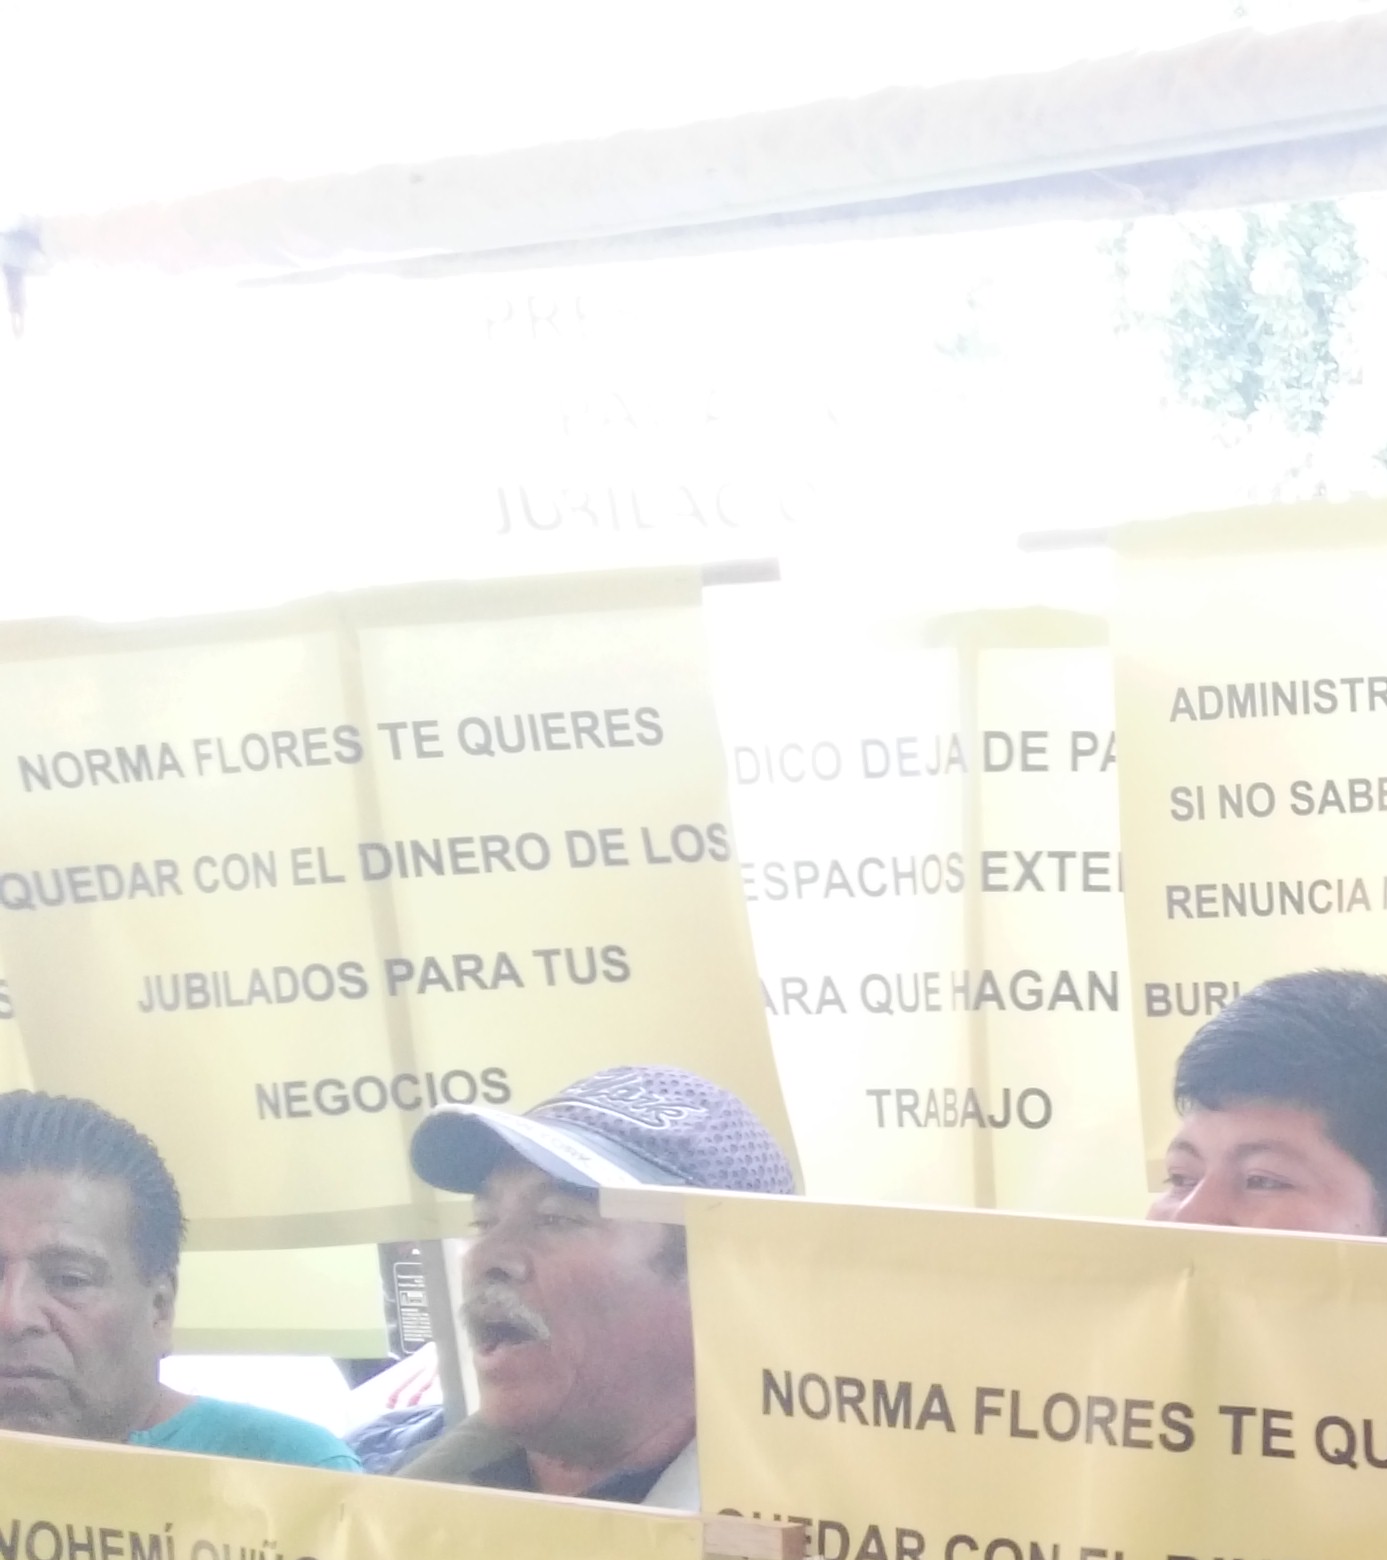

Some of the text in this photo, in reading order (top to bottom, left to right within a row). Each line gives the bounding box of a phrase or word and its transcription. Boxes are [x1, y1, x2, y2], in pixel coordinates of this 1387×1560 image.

[17, 706, 664, 793] NORMA FLORES TE QUIERES
[861, 732, 969, 779] DEJA
[983, 730, 1050, 773] DE
[1170, 786, 1205, 821] SI
[1218, 781, 1276, 819] NO
[0, 822, 733, 912] QUEDAR CON EL DINERO DE LOS
[1166, 878, 1372, 920] RENUNCIA
[137, 945, 631, 1013] JUBILADOS PARA TUS
[860, 972, 942, 1016] QUE
[952, 971, 1118, 1012] HAGAN
[256, 1068, 512, 1120] NEGOCIOS
[867, 1088, 1053, 1129] TRABAJO
[760, 1369, 956, 1434] NORMA
[973, 1386, 1196, 1454] FLORES
[1219, 1404, 1297, 1462] TE
